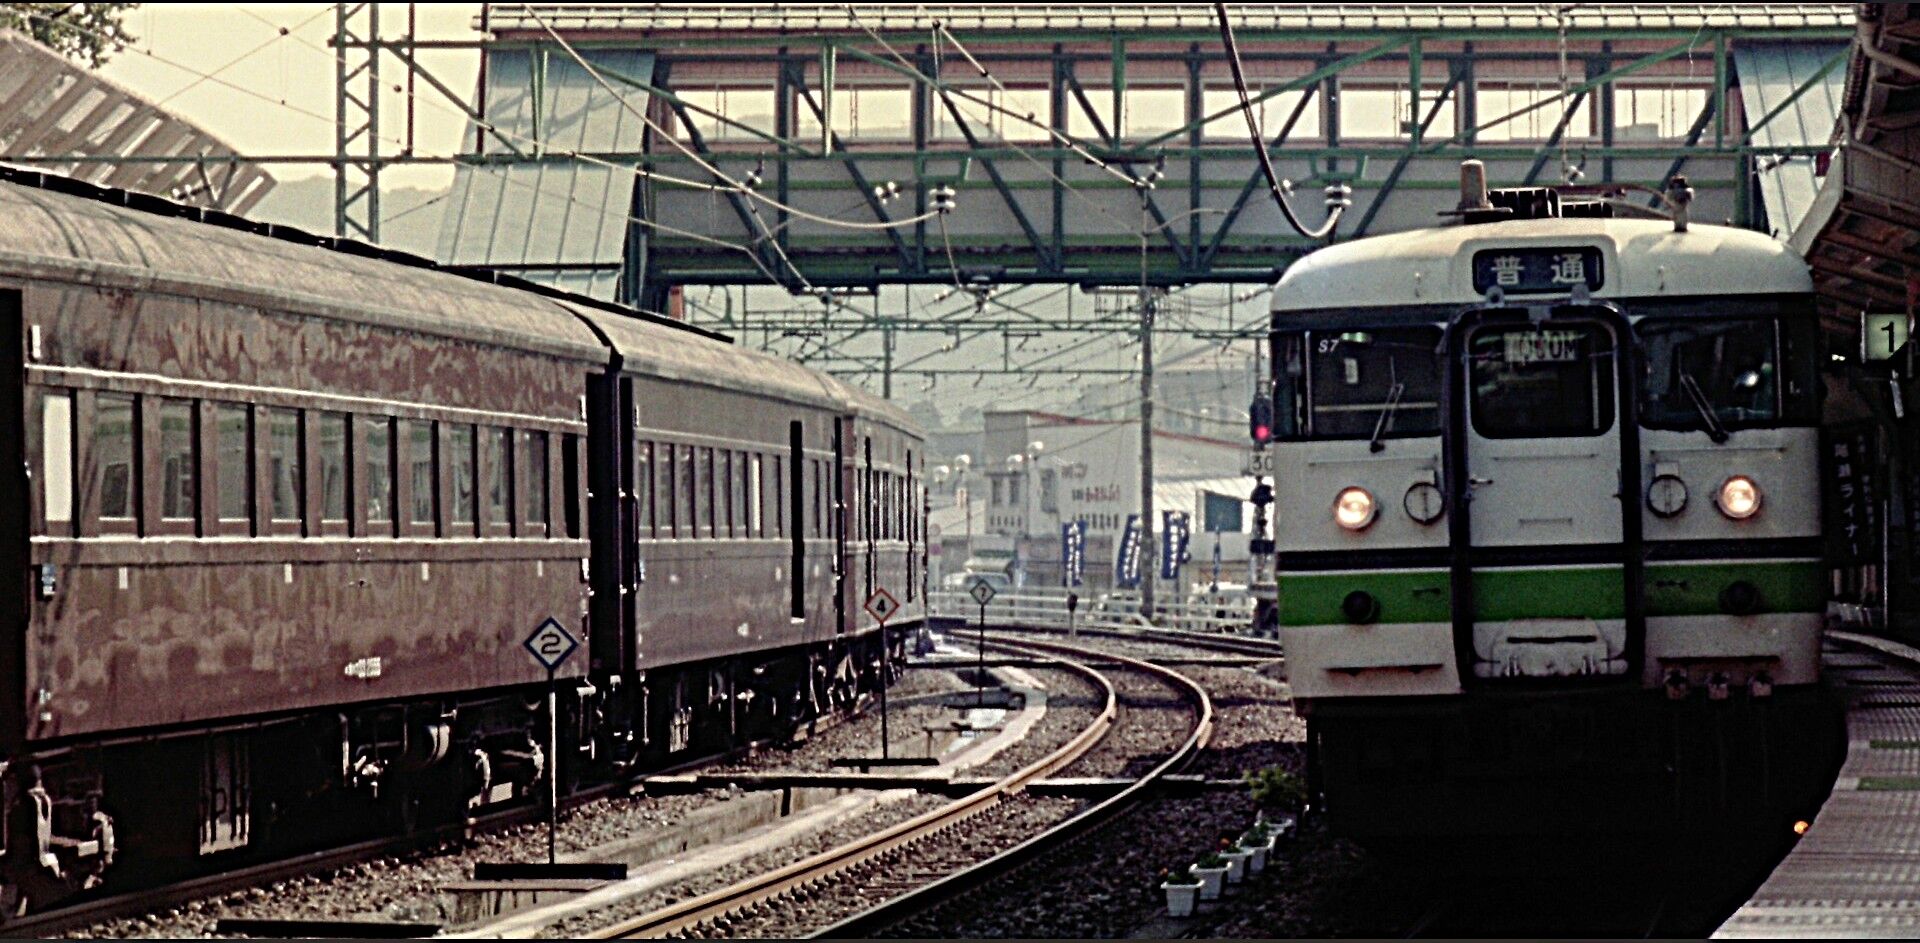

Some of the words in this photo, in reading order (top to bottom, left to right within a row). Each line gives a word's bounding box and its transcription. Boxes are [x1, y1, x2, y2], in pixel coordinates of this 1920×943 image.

[1490, 252, 1587, 285] 普通
[1318, 339, 1340, 354] S7
[1880, 321, 1895, 353] 1
[876, 598, 886, 613] 4
[540, 632, 562, 655] 2
